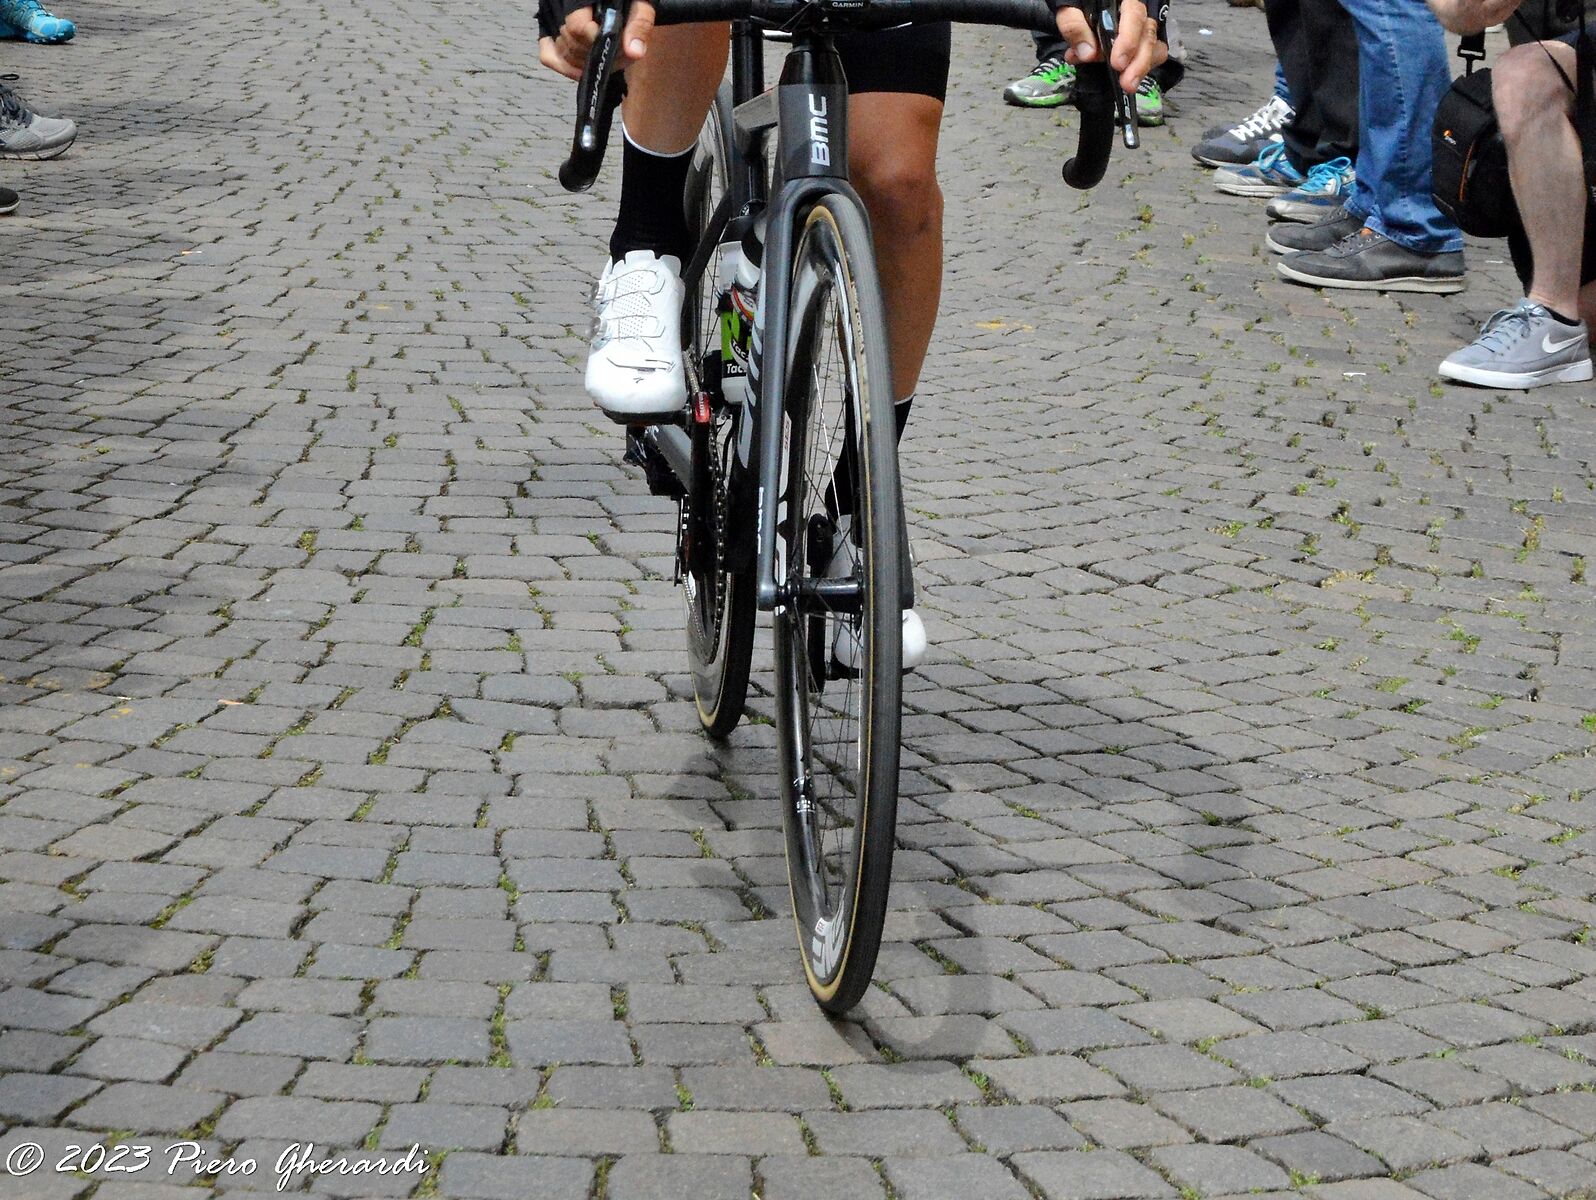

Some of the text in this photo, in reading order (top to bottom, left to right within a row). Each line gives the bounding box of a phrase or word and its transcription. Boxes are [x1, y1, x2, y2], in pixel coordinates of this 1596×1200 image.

[832, 0, 865, 8] GARMIN
[808, 93, 831, 167] BMC
[732, 338, 750, 361] Tac
[726, 363, 746, 374] Tac
